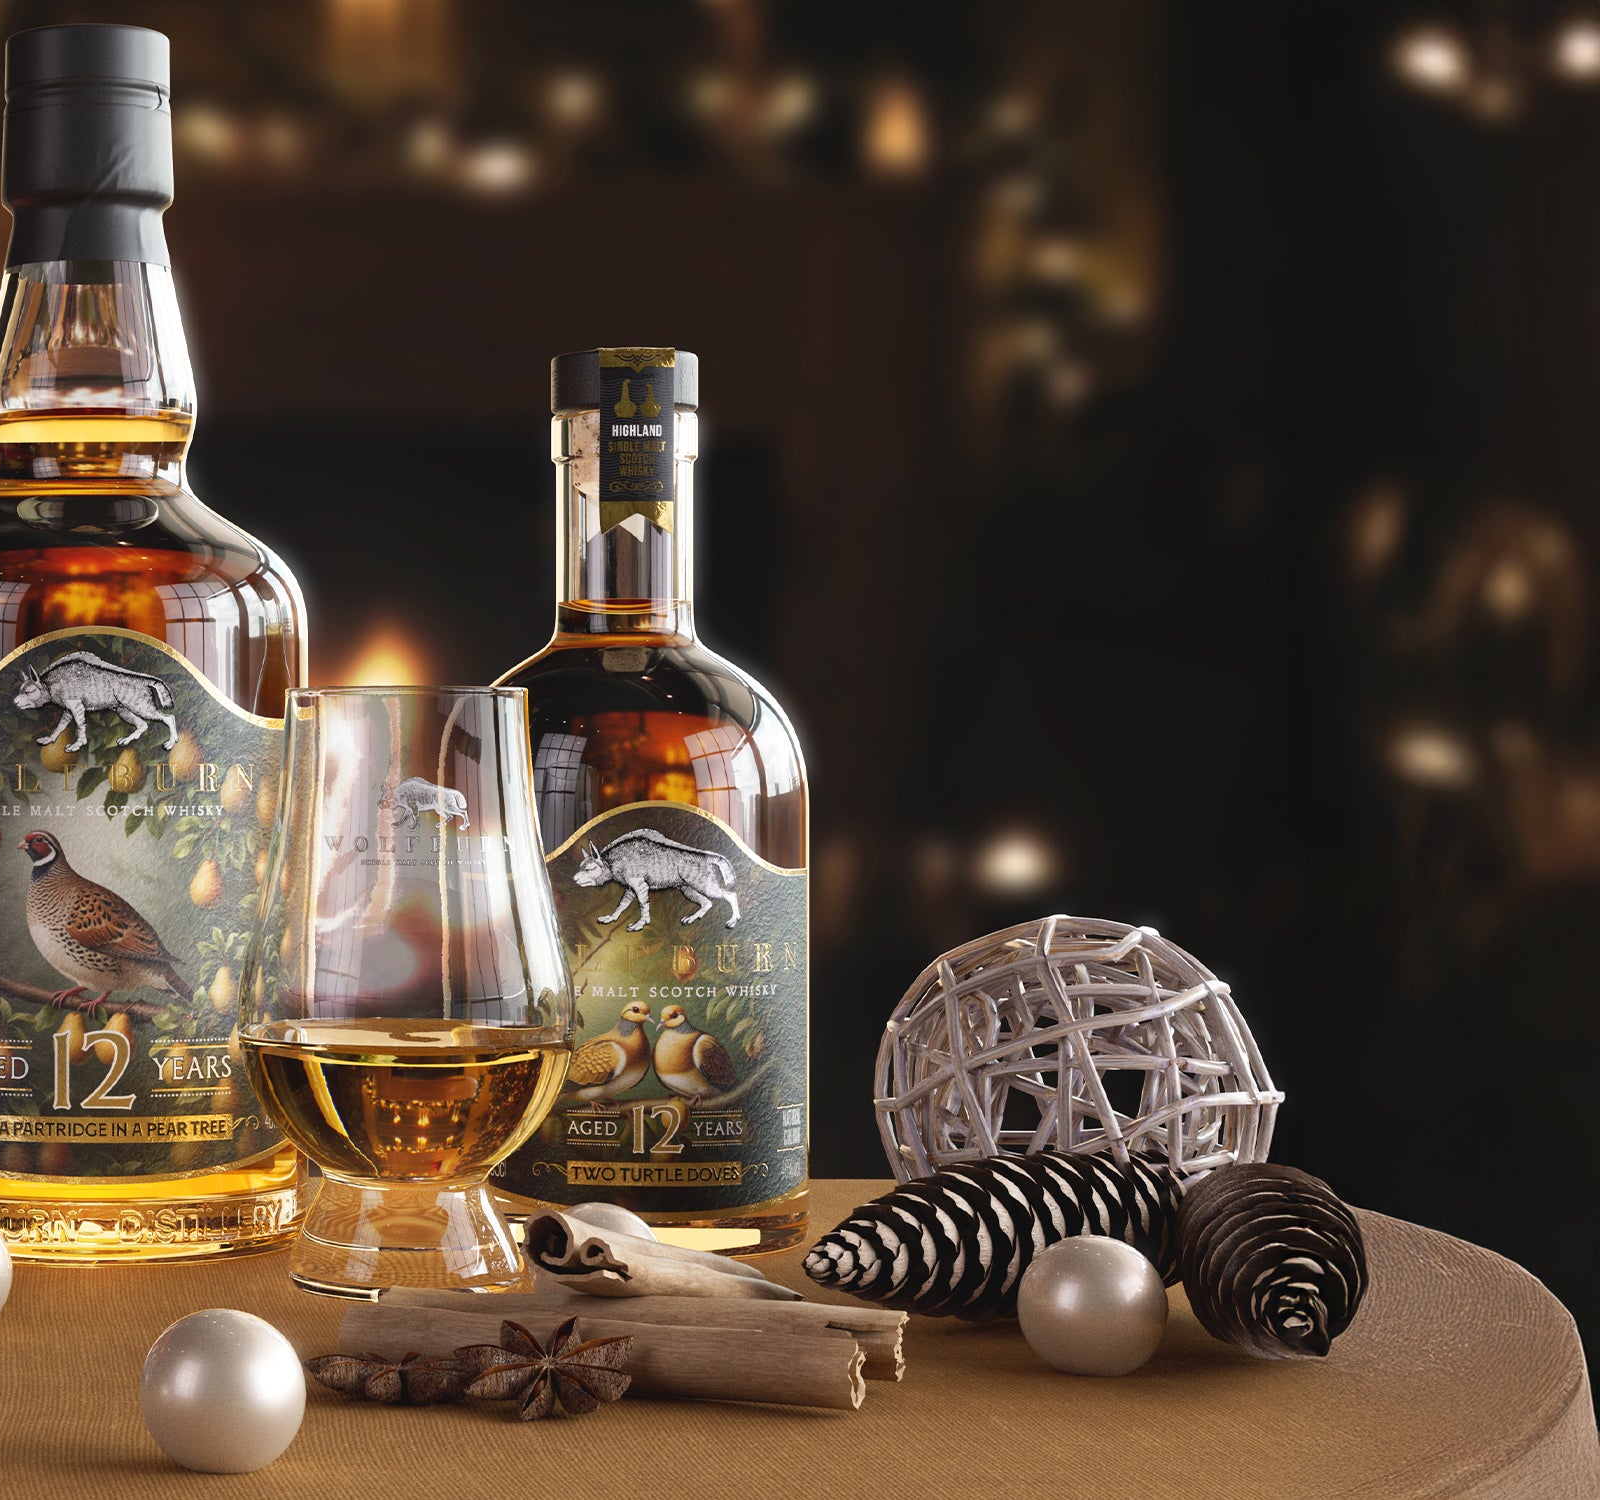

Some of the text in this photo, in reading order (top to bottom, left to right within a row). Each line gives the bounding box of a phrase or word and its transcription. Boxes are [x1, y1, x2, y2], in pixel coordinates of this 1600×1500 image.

[611, 424, 663, 437] HIGHLAND
[608, 441, 640, 453] SINGLE
[620, 453, 655, 464] SCOTCH
[620, 465, 655, 476] WHISKY
[30, 804, 76, 817] MALT
[86, 804, 154, 817] SCOTCH
[163, 804, 225, 817] WHISKY
[574, 941, 797, 974] LFBURN
[591, 986, 639, 998] MALT
[649, 986, 717, 998] SCOTCH
[725, 984, 778, 997] WHISKY
[51, 1029, 137, 1111] 12
[151, 1054, 233, 1081] YEARS
[0, 1120, 10, 1136] A
[13, 1121, 108, 1138] PARTRIDGE
[111, 1122, 127, 1137] IN
[132, 1122, 143, 1137] A
[148, 1121, 188, 1137] PEAR
[190, 1119, 227, 1136] TREE
[567, 1103, 743, 1154] AGED 12 YEARS
[571, 1166, 740, 1183] TWO TURTLE DOVES
